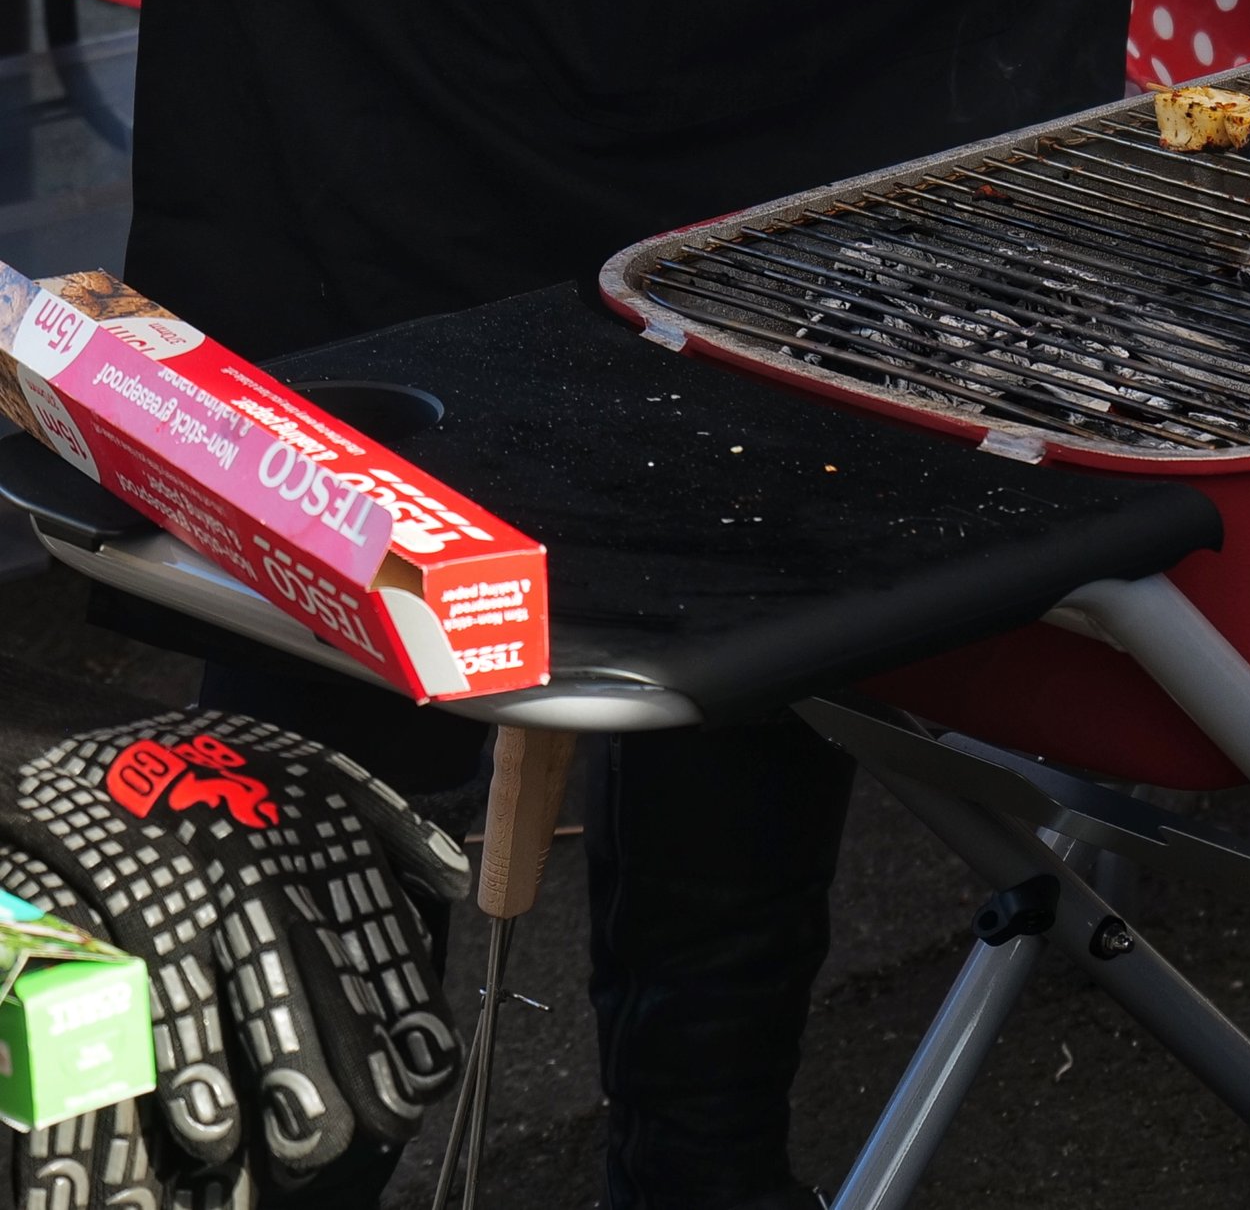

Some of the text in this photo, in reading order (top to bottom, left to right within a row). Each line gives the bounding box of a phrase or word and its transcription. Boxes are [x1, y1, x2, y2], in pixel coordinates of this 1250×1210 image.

[34, 298, 84, 355] 15m
[92, 362, 178, 422] greaseproof
[36, 405, 88, 460] 15m
[170, 408, 239, 471] Non-stick
[258, 440, 375, 548] TESCO
[263, 556, 386, 663] TESCO
